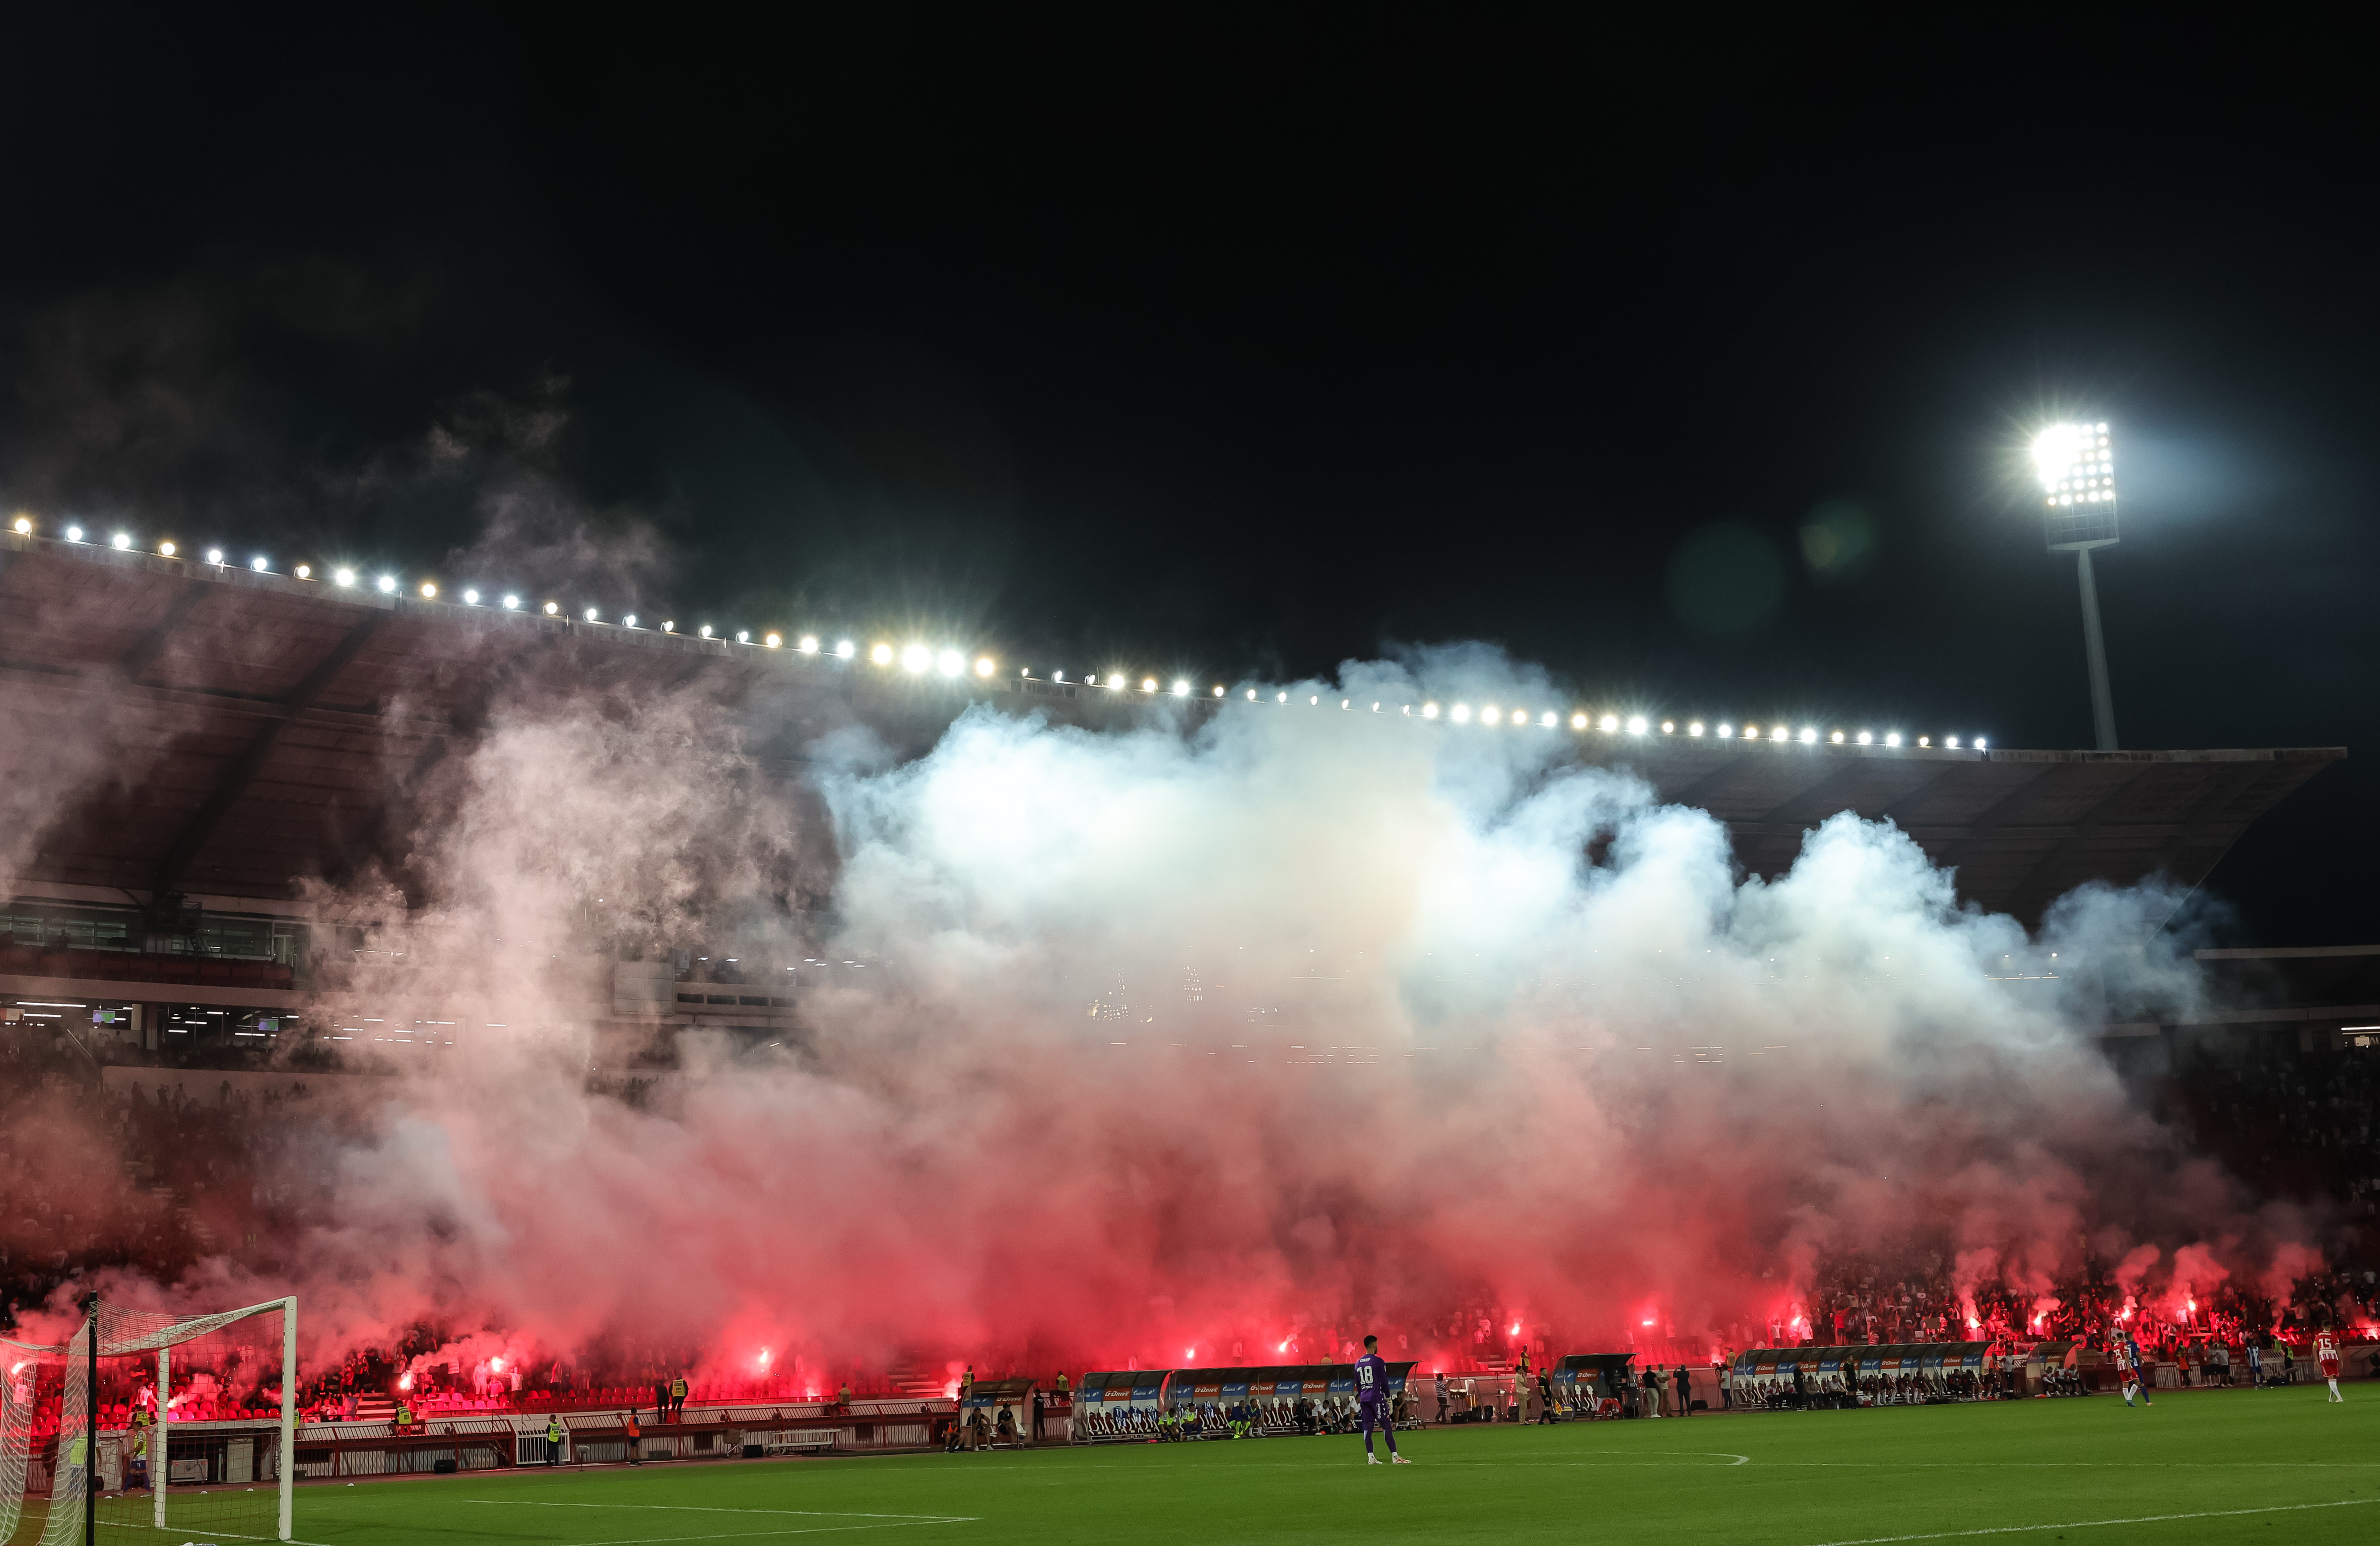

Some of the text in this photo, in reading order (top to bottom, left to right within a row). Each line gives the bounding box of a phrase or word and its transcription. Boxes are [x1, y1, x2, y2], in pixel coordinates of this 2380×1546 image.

[2319, 1338, 2332, 1350] 15
[1356, 1366, 1373, 1385] 18
[1115, 1408, 1122, 1418] 11
